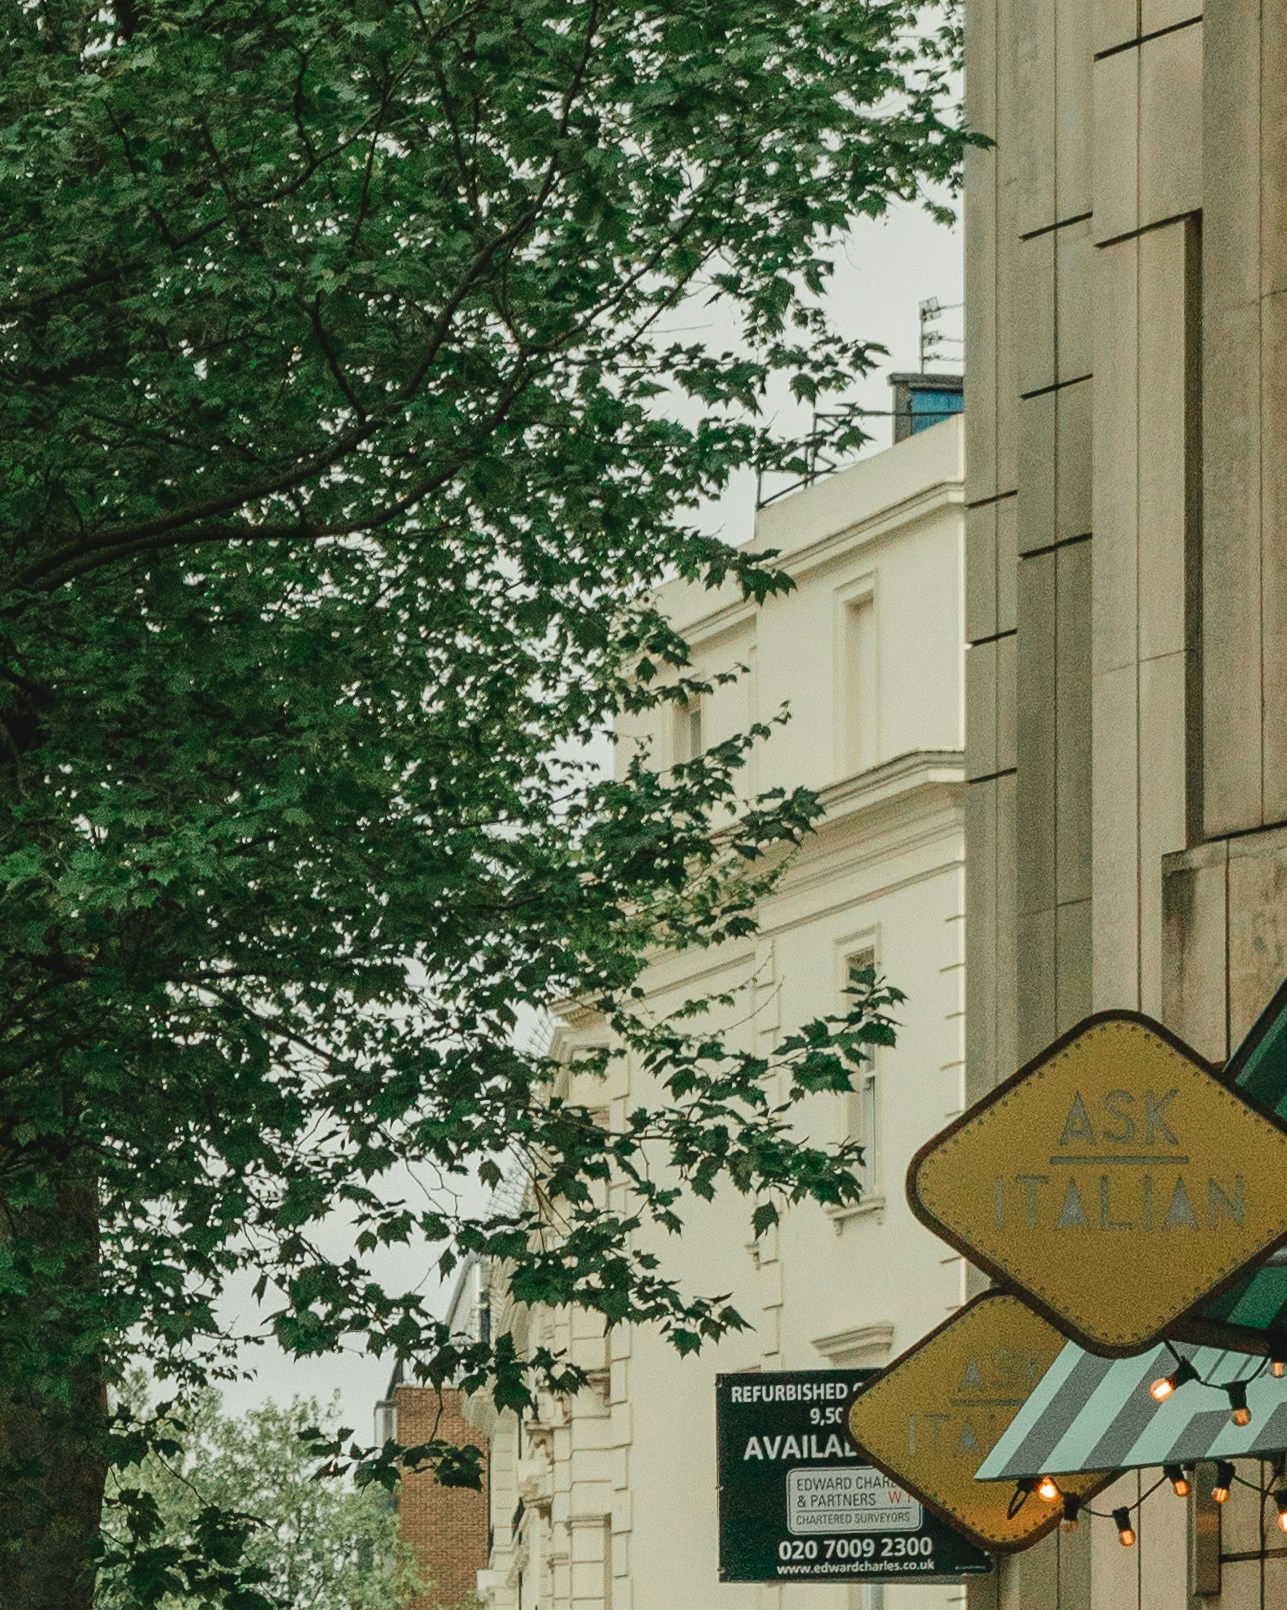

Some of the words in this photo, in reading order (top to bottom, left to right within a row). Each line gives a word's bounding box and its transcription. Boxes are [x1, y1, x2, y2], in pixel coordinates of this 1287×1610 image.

[1059, 1088, 1180, 1146] ASK
[993, 1174, 1245, 1232] ITALIAN
[731, 1383, 848, 1403] REFURBISHED
[796, 1477, 852, 1492] EDWARD
[797, 1495, 807, 1508] &
[811, 1492, 876, 1508] PARTNERS
[796, 1513, 852, 1526] CHARTERED
[855, 1511, 911, 1525] SURVEYORS
[778, 1540, 818, 1560] 020
[823, 1538, 875, 1559] 7009
[881, 1536, 933, 1557] 2300
[777, 1558, 935, 1575] www.edwardcharles.co.uk
